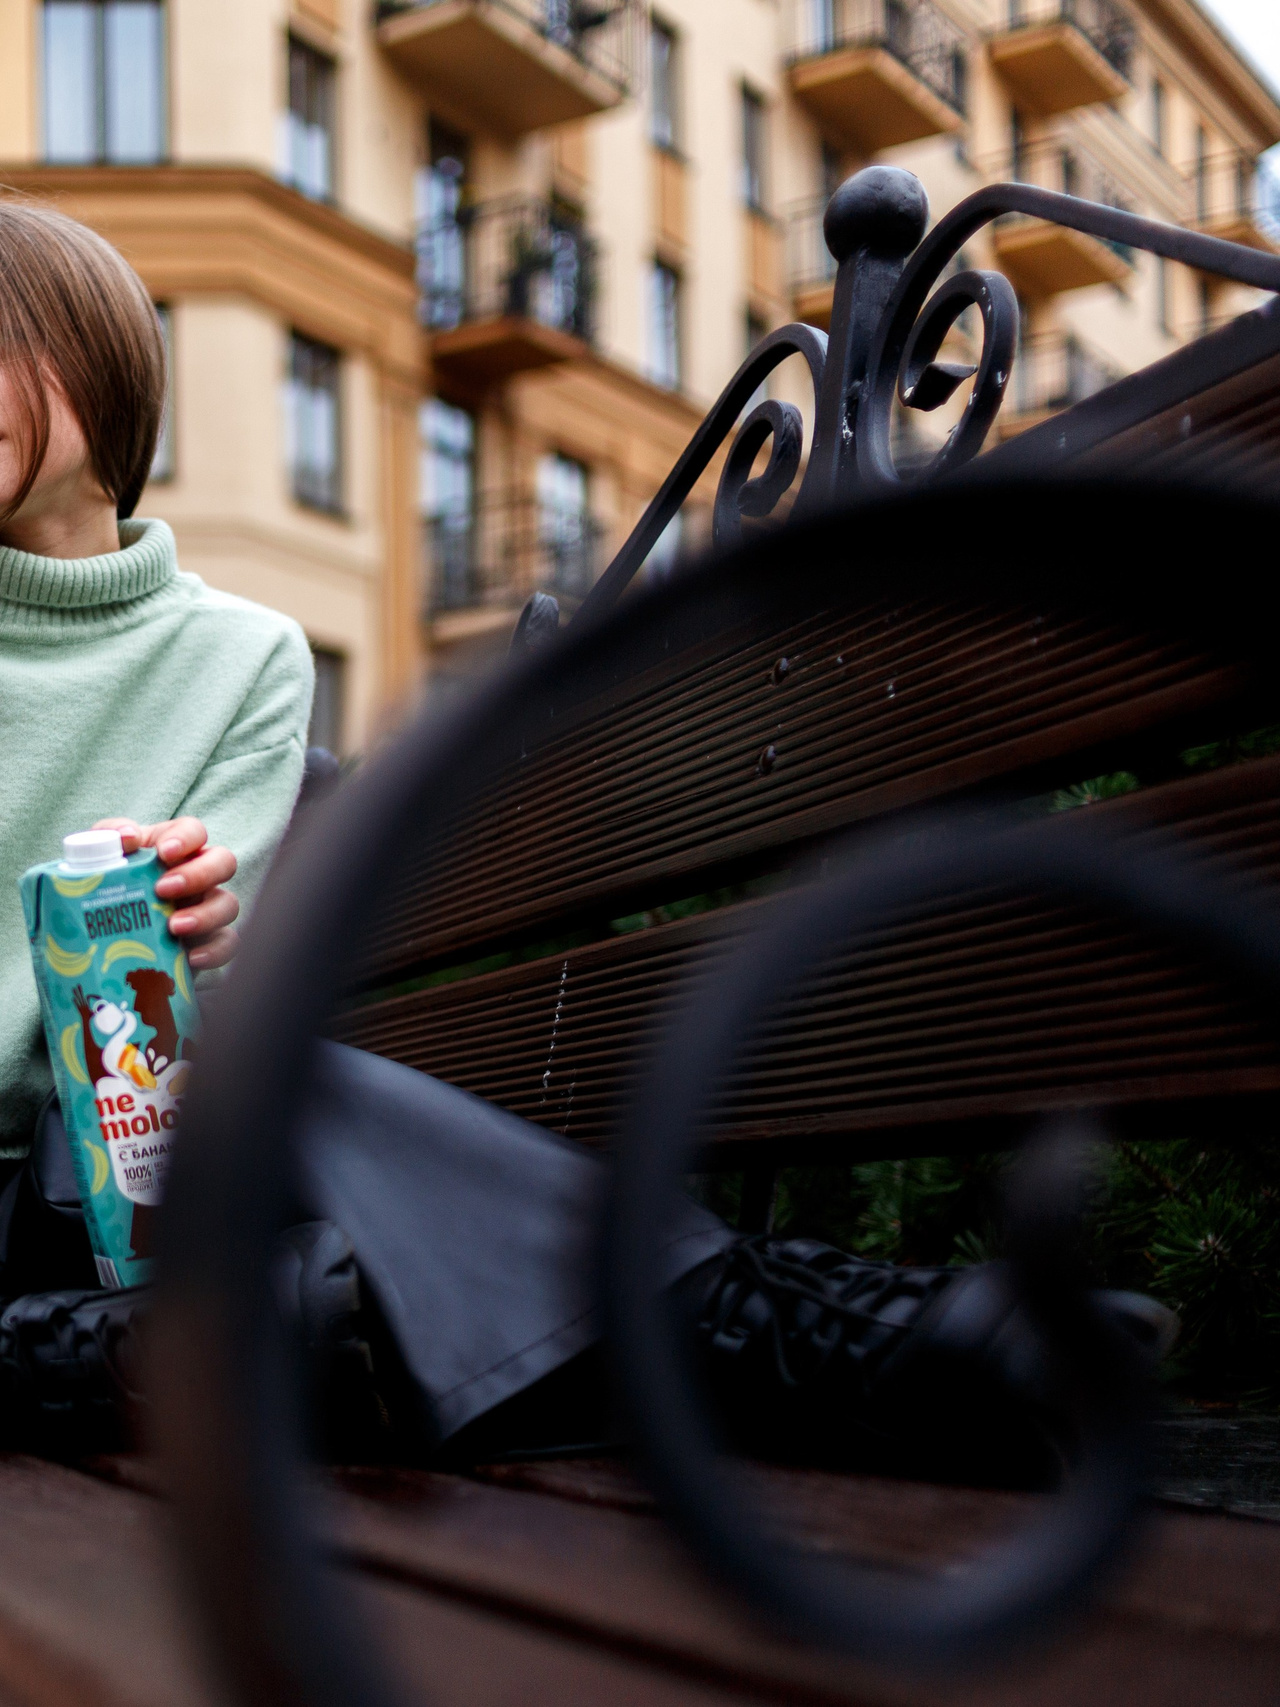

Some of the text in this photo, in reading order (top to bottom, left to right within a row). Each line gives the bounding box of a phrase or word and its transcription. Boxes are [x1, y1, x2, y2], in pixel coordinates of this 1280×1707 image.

[84, 900, 152, 939] BARISTA
[95, 1093, 135, 1117] ne
[99, 1099, 182, 1141] molo
[119, 1150, 128, 1162] С
[124, 1164, 152, 1180] 100%
